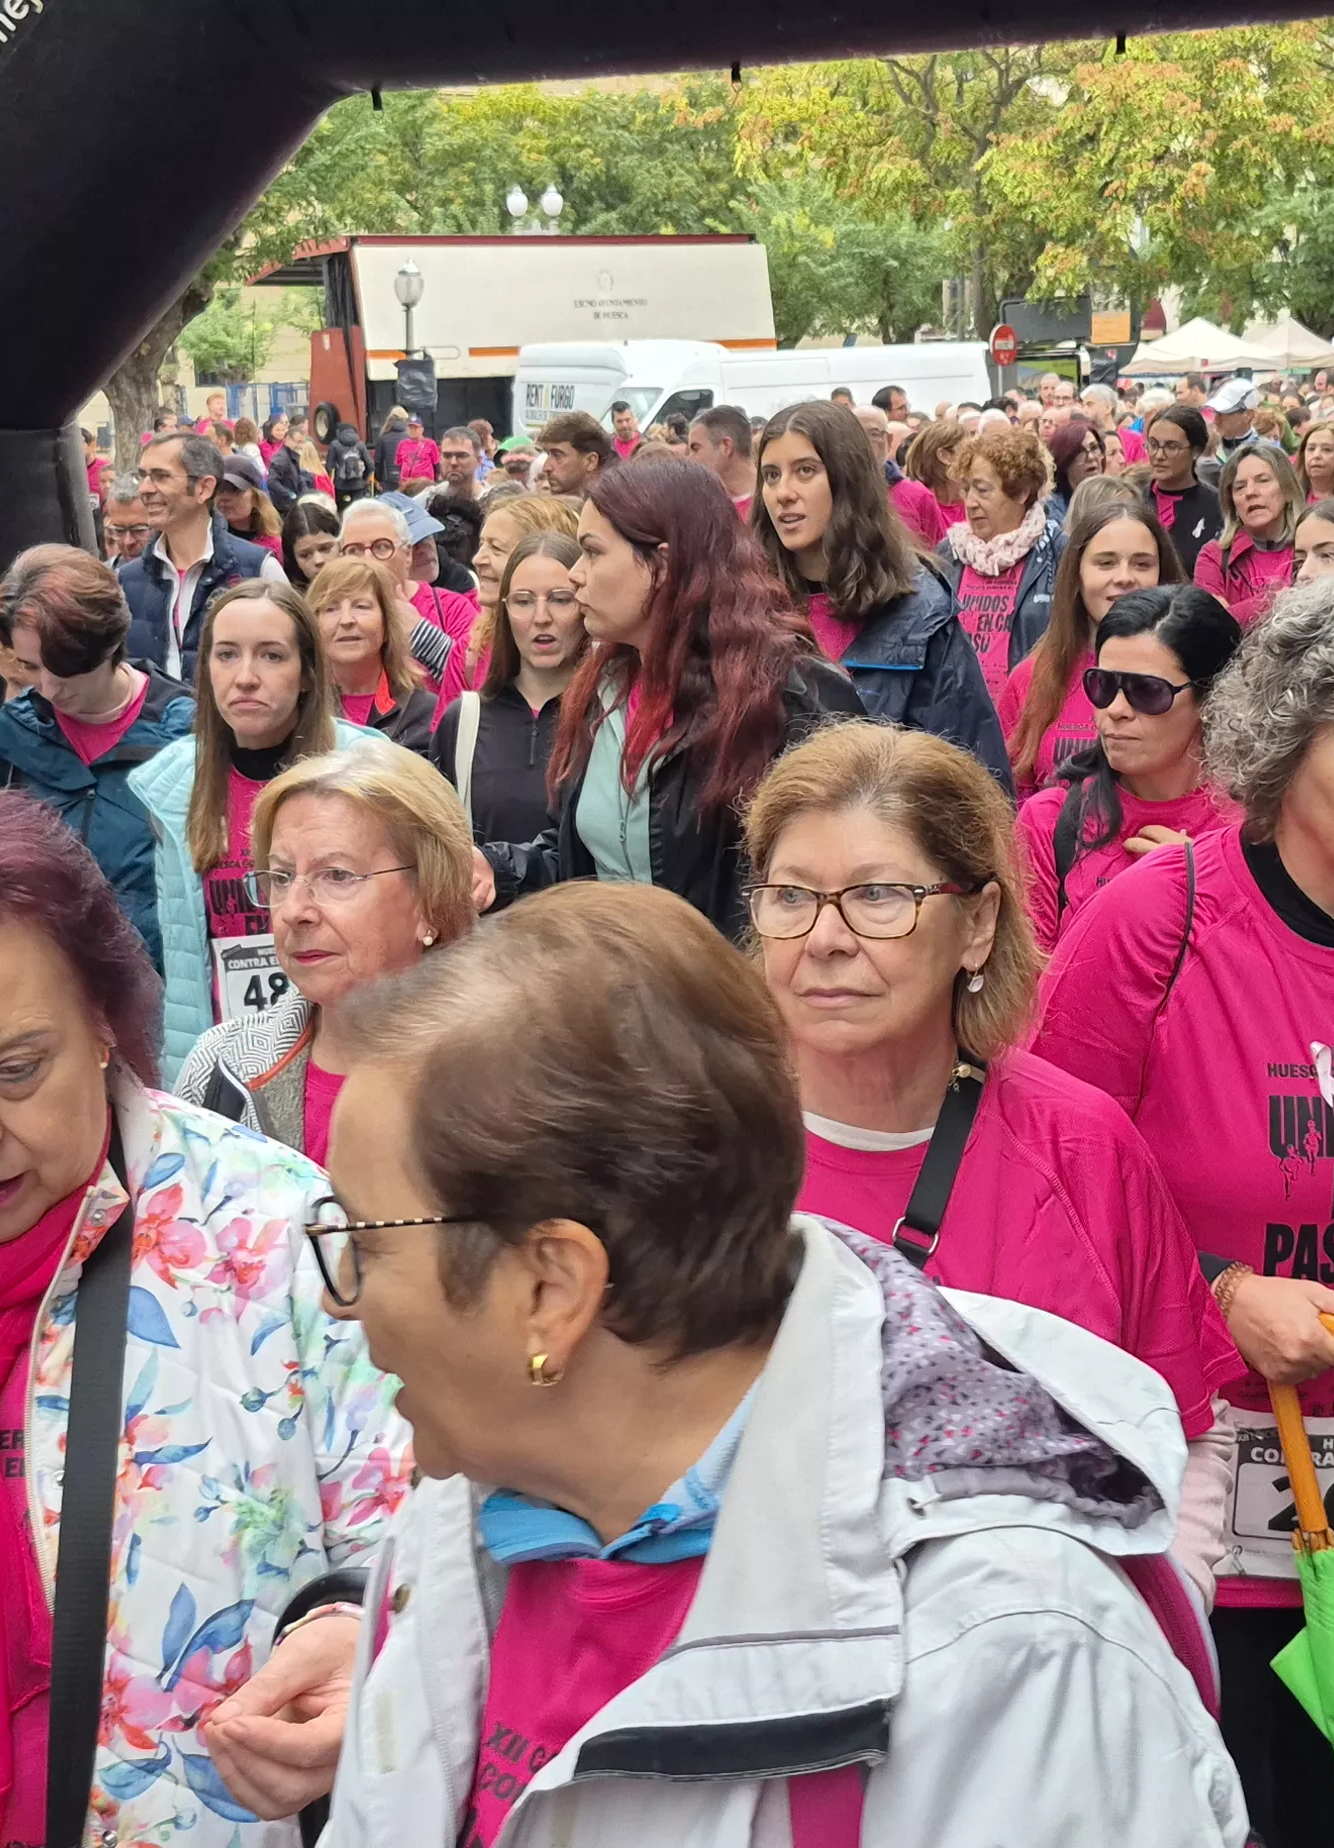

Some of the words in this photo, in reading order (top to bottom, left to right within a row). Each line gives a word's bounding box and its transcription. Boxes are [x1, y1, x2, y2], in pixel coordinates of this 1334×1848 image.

[977, 614, 993, 632] EN
[995, 614, 1012, 632] CA
[228, 957, 268, 970] CONTRA
[1267, 1062, 1317, 1078] HUESC
